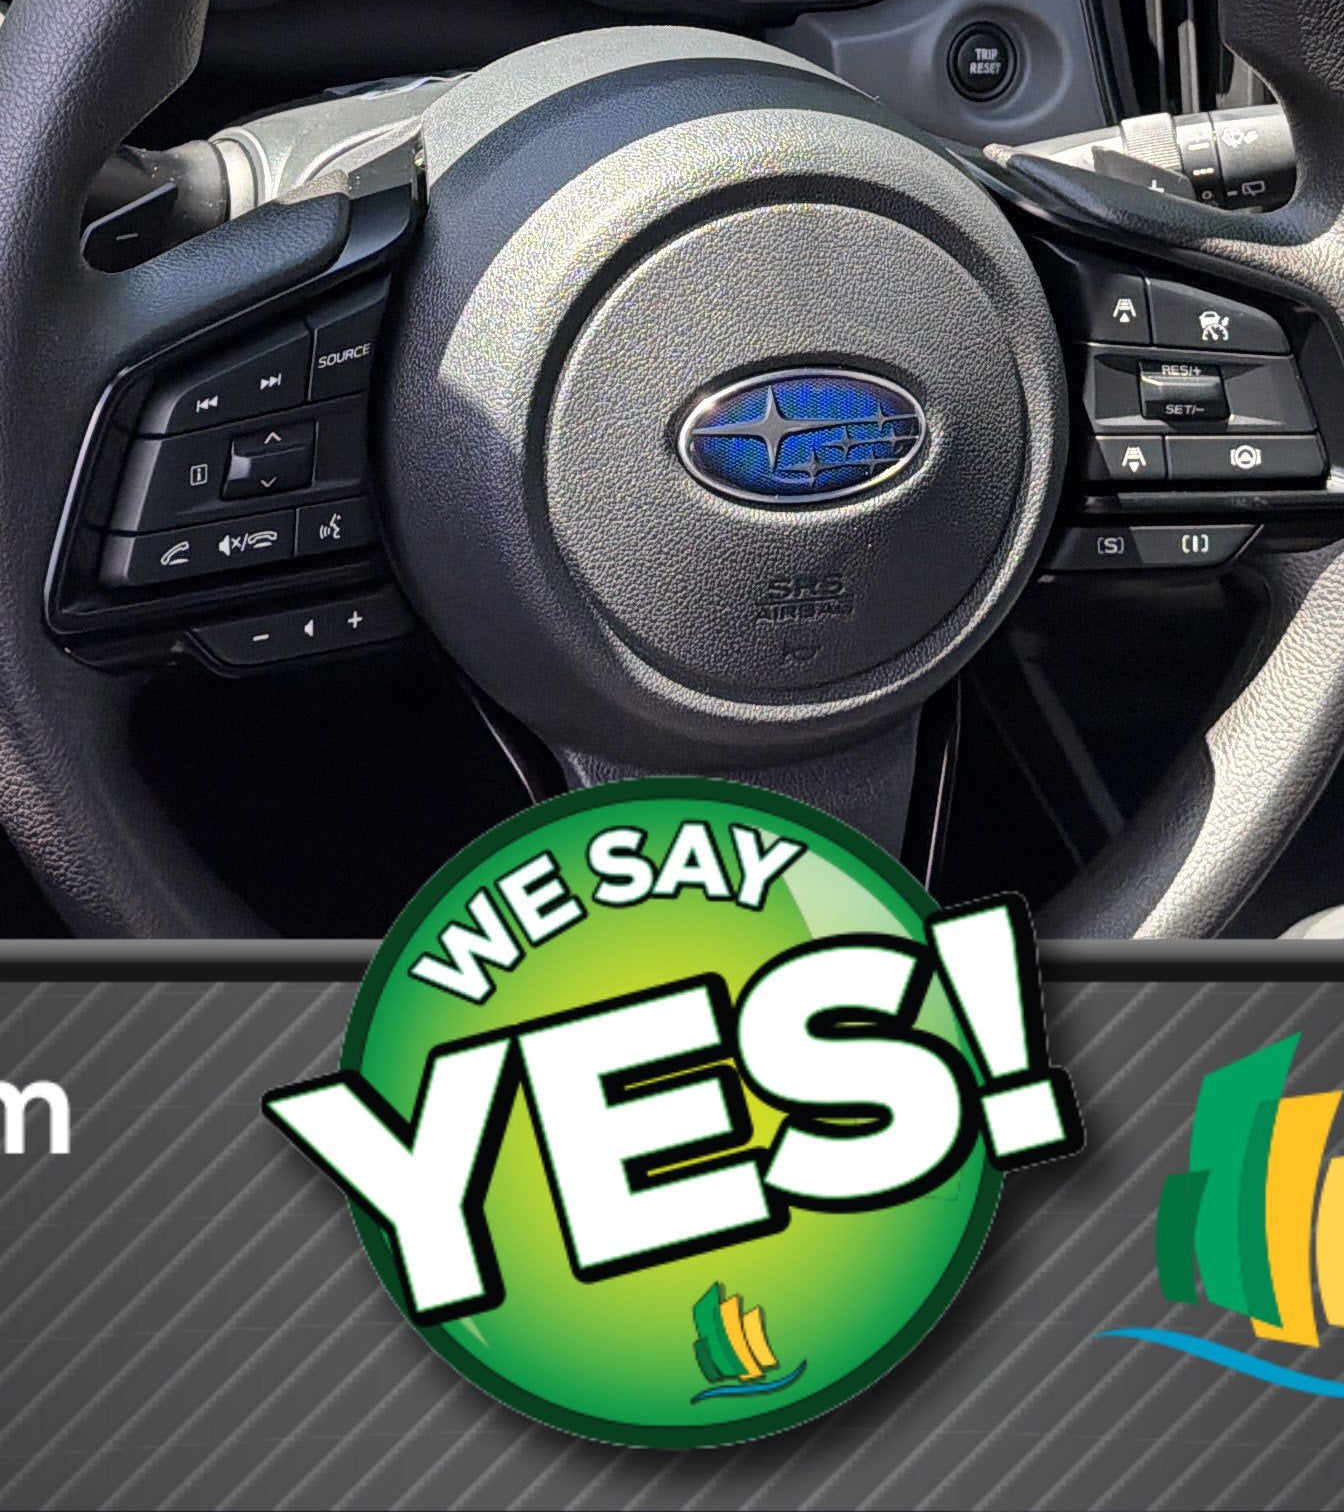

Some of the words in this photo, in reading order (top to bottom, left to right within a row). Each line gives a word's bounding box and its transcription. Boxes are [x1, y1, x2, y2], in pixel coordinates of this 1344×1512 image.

[975, 47, 998, 61] TRIP
[969, 61, 1001, 75] RESET
[318, 342, 371, 369] SOURCE
